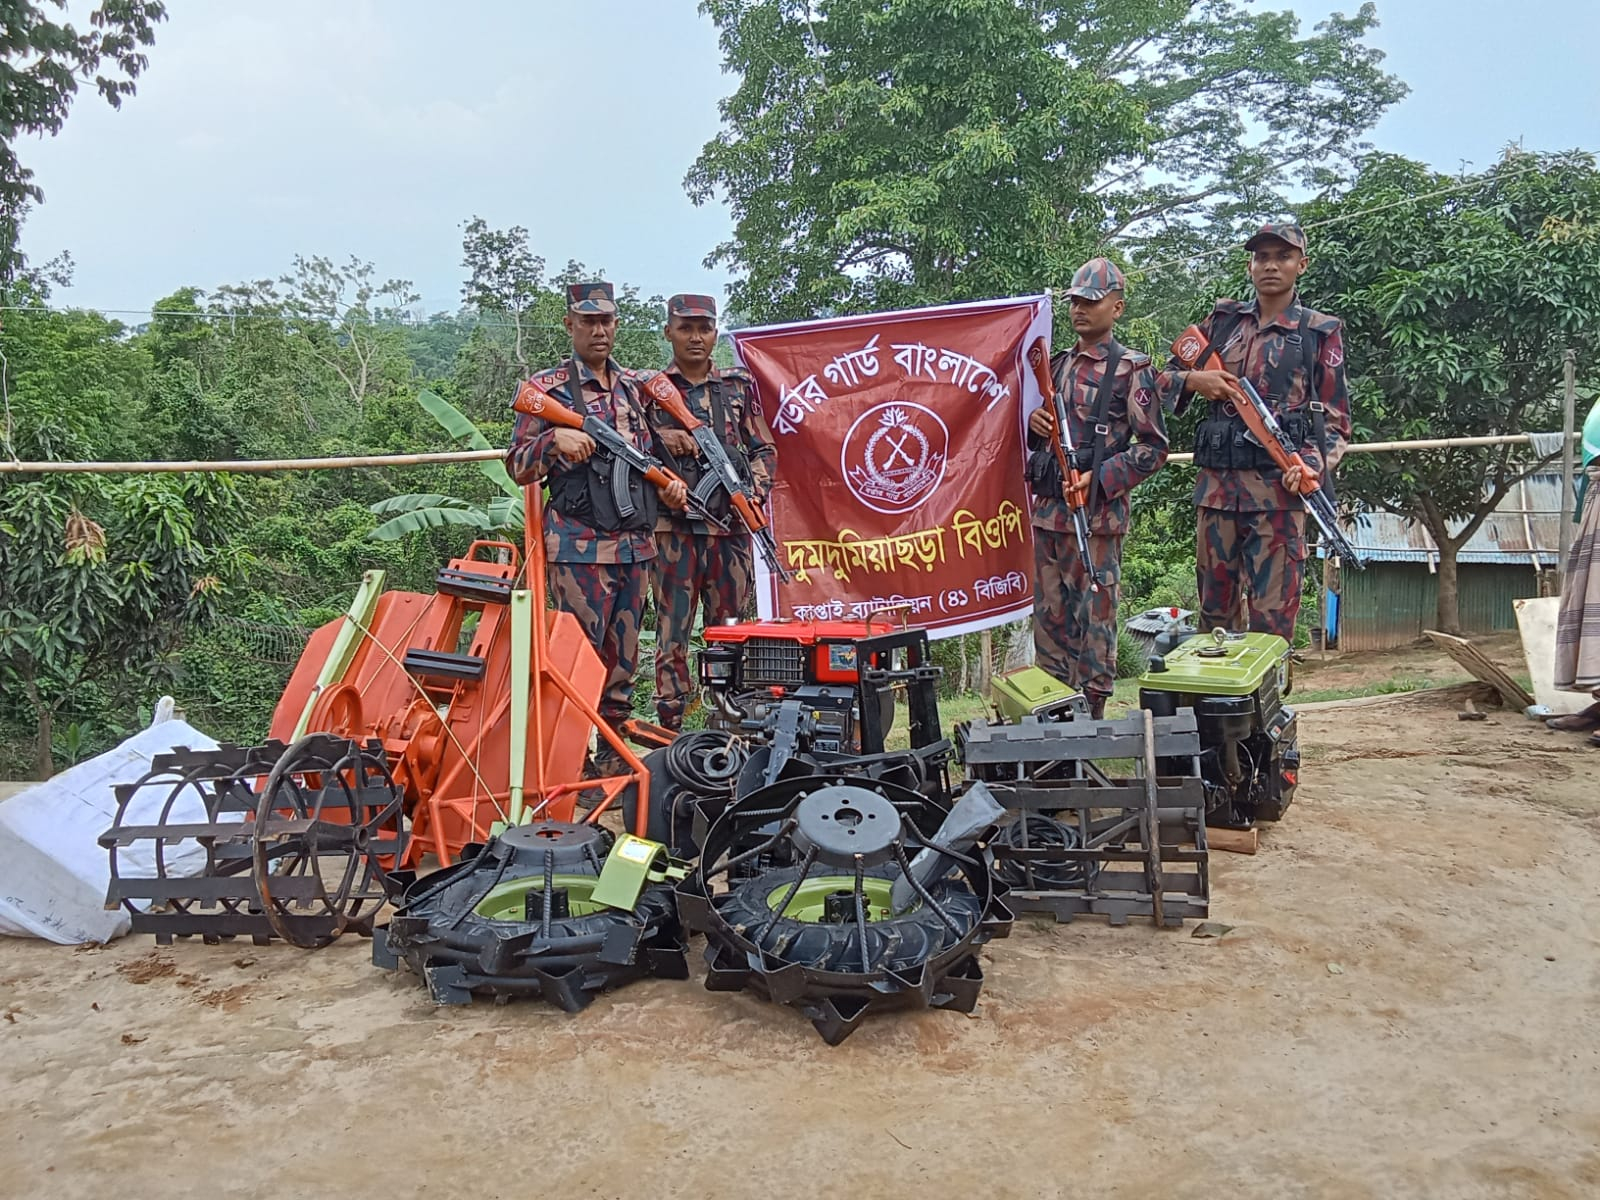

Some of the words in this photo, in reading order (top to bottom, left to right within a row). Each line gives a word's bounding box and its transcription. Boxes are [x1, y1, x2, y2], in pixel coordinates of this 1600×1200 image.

[772, 374, 829, 434] বর্ডার
[823, 334, 880, 387] গার্ড
[889, 342, 1010, 412] বাংলাদেশ
[782, 528, 946, 586] দুমদুমিয়াছড়া
[951, 500, 1024, 559] বিওপি
[791, 598, 845, 623] কাপ্তাই
[938, 589, 968, 613] (৪১
[972, 571, 1027, 602] বিজিবি)
